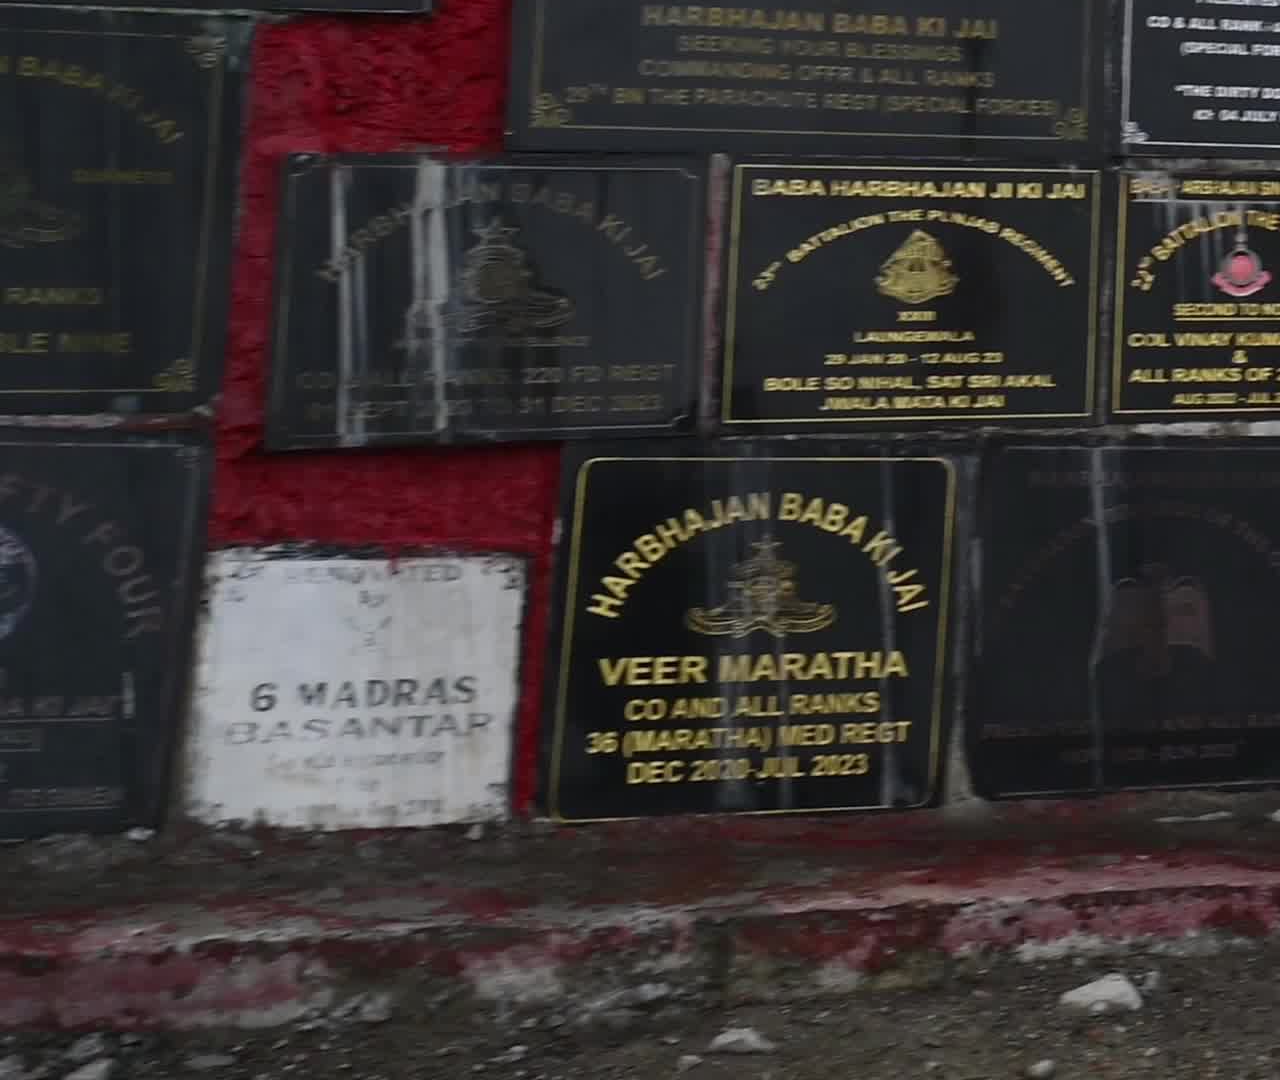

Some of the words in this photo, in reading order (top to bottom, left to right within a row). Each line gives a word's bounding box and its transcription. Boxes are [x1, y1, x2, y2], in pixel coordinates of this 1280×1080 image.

[640, 4, 826, 34] HARBHAJAN
[830, 12, 909, 36] BABA
[915, 15, 946, 37] KI
[954, 18, 998, 40] JAI
[676, 33, 775, 56] SEEKING
[845, 41, 963, 63] BLESSINGS
[751, 178, 827, 197] BABA
[829, 178, 986, 199] HARBHAJAN
[989, 182, 1014, 199] JI
[1015, 182, 1043, 200] KI
[1045, 183, 1086, 200] JAI
[785, 213, 887, 264] BATTALION
[886, 208, 926, 223] THE
[926, 209, 1001, 235] PUNJAB
[999, 227, 1077, 289] REGIMENT
[1172, 302, 1238, 317] SECOND
[1239, 302, 1260, 316] TO
[1127, 332, 1172, 348] COL
[1231, 349, 1250, 364] &
[762, 376, 822, 392] BOLE
[822, 375, 856, 391] SO
[924, 374, 966, 390] SAT
[966, 374, 1001, 389] SRI
[1002, 374, 1057, 388] AKAL
[1127, 368, 1169, 383] ALL
[1171, 367, 1243, 383] RANKS
[1244, 367, 1274, 382] OF
[948, 394, 972, 409] KI
[972, 394, 1007, 408] JAI
[585, 491, 771, 619] HARBHAJAN
[777, 491, 869, 546] BABA
[862, 529, 905, 568] KI
[886, 568, 931, 613] JAI
[597, 655, 709, 688] VEER
[717, 649, 910, 684] MARATHA
[250, 682, 279, 712] 6
[296, 675, 479, 709] MADRAS
[623, 697, 669, 722] CO
[670, 696, 725, 720] AND
[734, 694, 786, 718] ALL
[788, 691, 882, 716] RANKS
[584, 730, 620, 756] 36
[622, 725, 773, 758] (MARATHA)
[778, 722, 837, 747] MED
[838, 720, 913, 745] REGT
[625, 760, 686, 785] DEC
[810, 752, 871, 778] 2023
